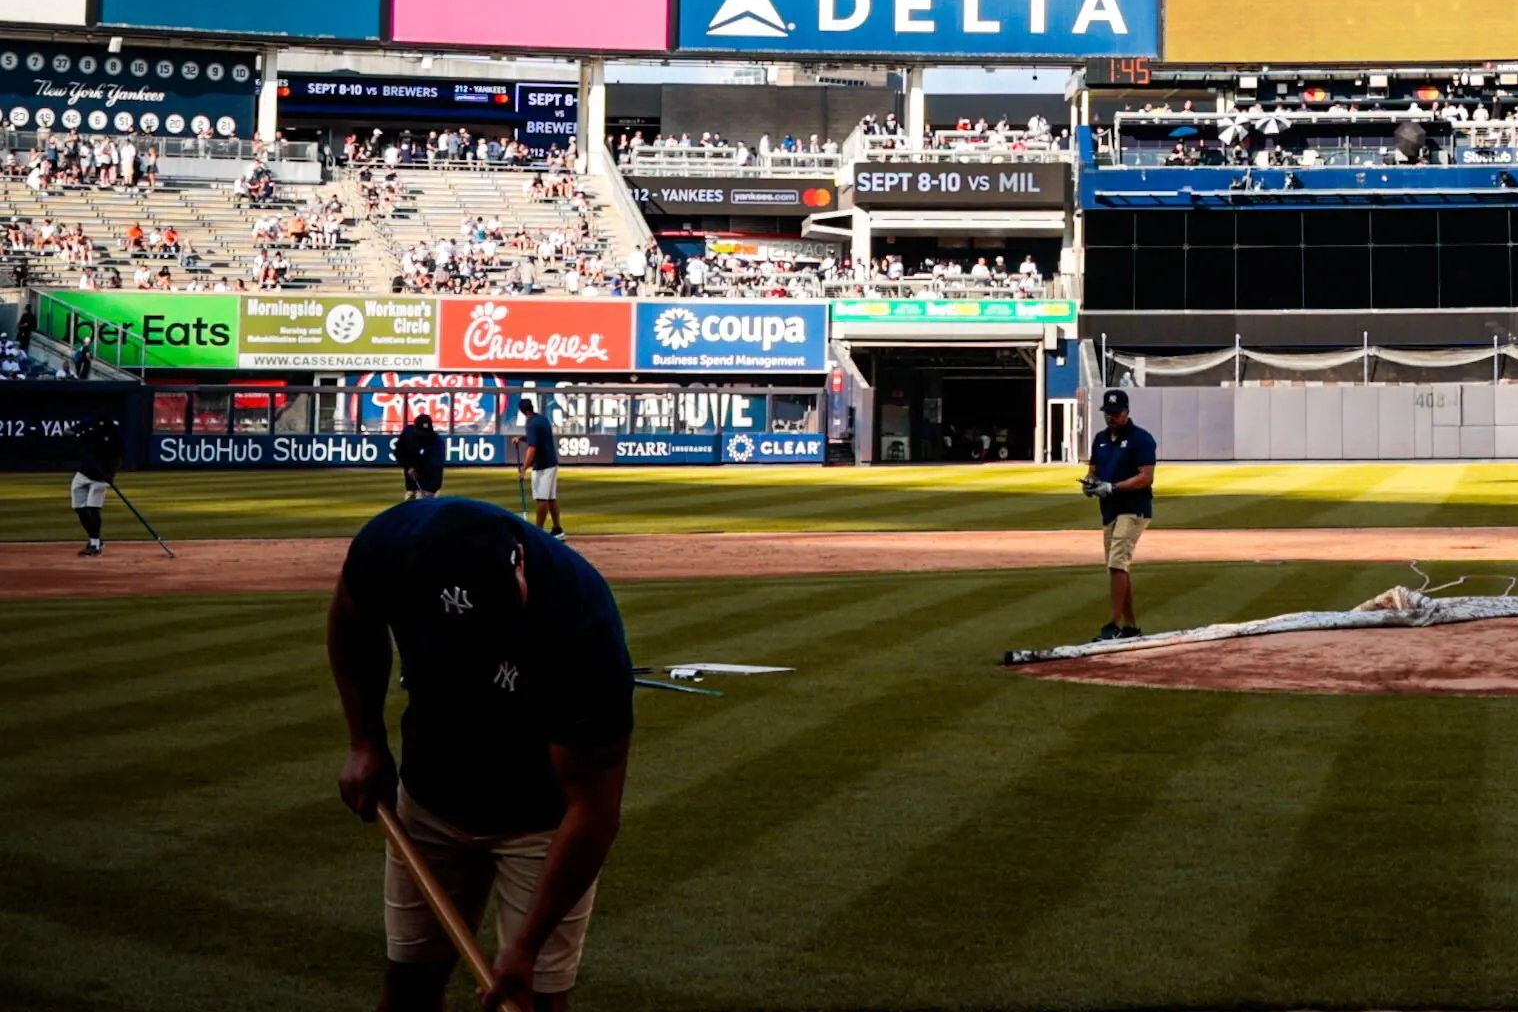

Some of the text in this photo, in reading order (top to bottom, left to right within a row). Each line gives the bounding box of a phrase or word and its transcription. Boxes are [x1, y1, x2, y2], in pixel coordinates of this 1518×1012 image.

[1110, 56, 1149, 85] 1:45
[33, 78, 165, 108] New York Yankees
[308, 83, 337, 95] SEPT
[340, 84, 362, 96] 8-10
[383, 86, 438, 98] BREWERS
[528, 93, 562, 106] SEPT
[857, 172, 912, 192] SEPT
[918, 172, 961, 192] 8-10
[1000, 172, 1040, 193] MIL
[662, 189, 723, 202] YANKEES
[734, 191, 796, 202] yankees.com
[247, 299, 323, 320] Morningside
[143, 315, 230, 346] Eats
[394, 318, 430, 334] Circle
[702, 315, 805, 351] coupa
[463, 312, 607, 366] Chick-fil-A
[254, 356, 423, 367] WWW.CASSENACARE.COM
[652, 354, 804, 367] Business Spend Management
[160, 439, 262, 463] StubHub
[273, 438, 377, 461] StubHub
[616, 441, 667, 456] STARR
[760, 441, 820, 455] CLEAR
